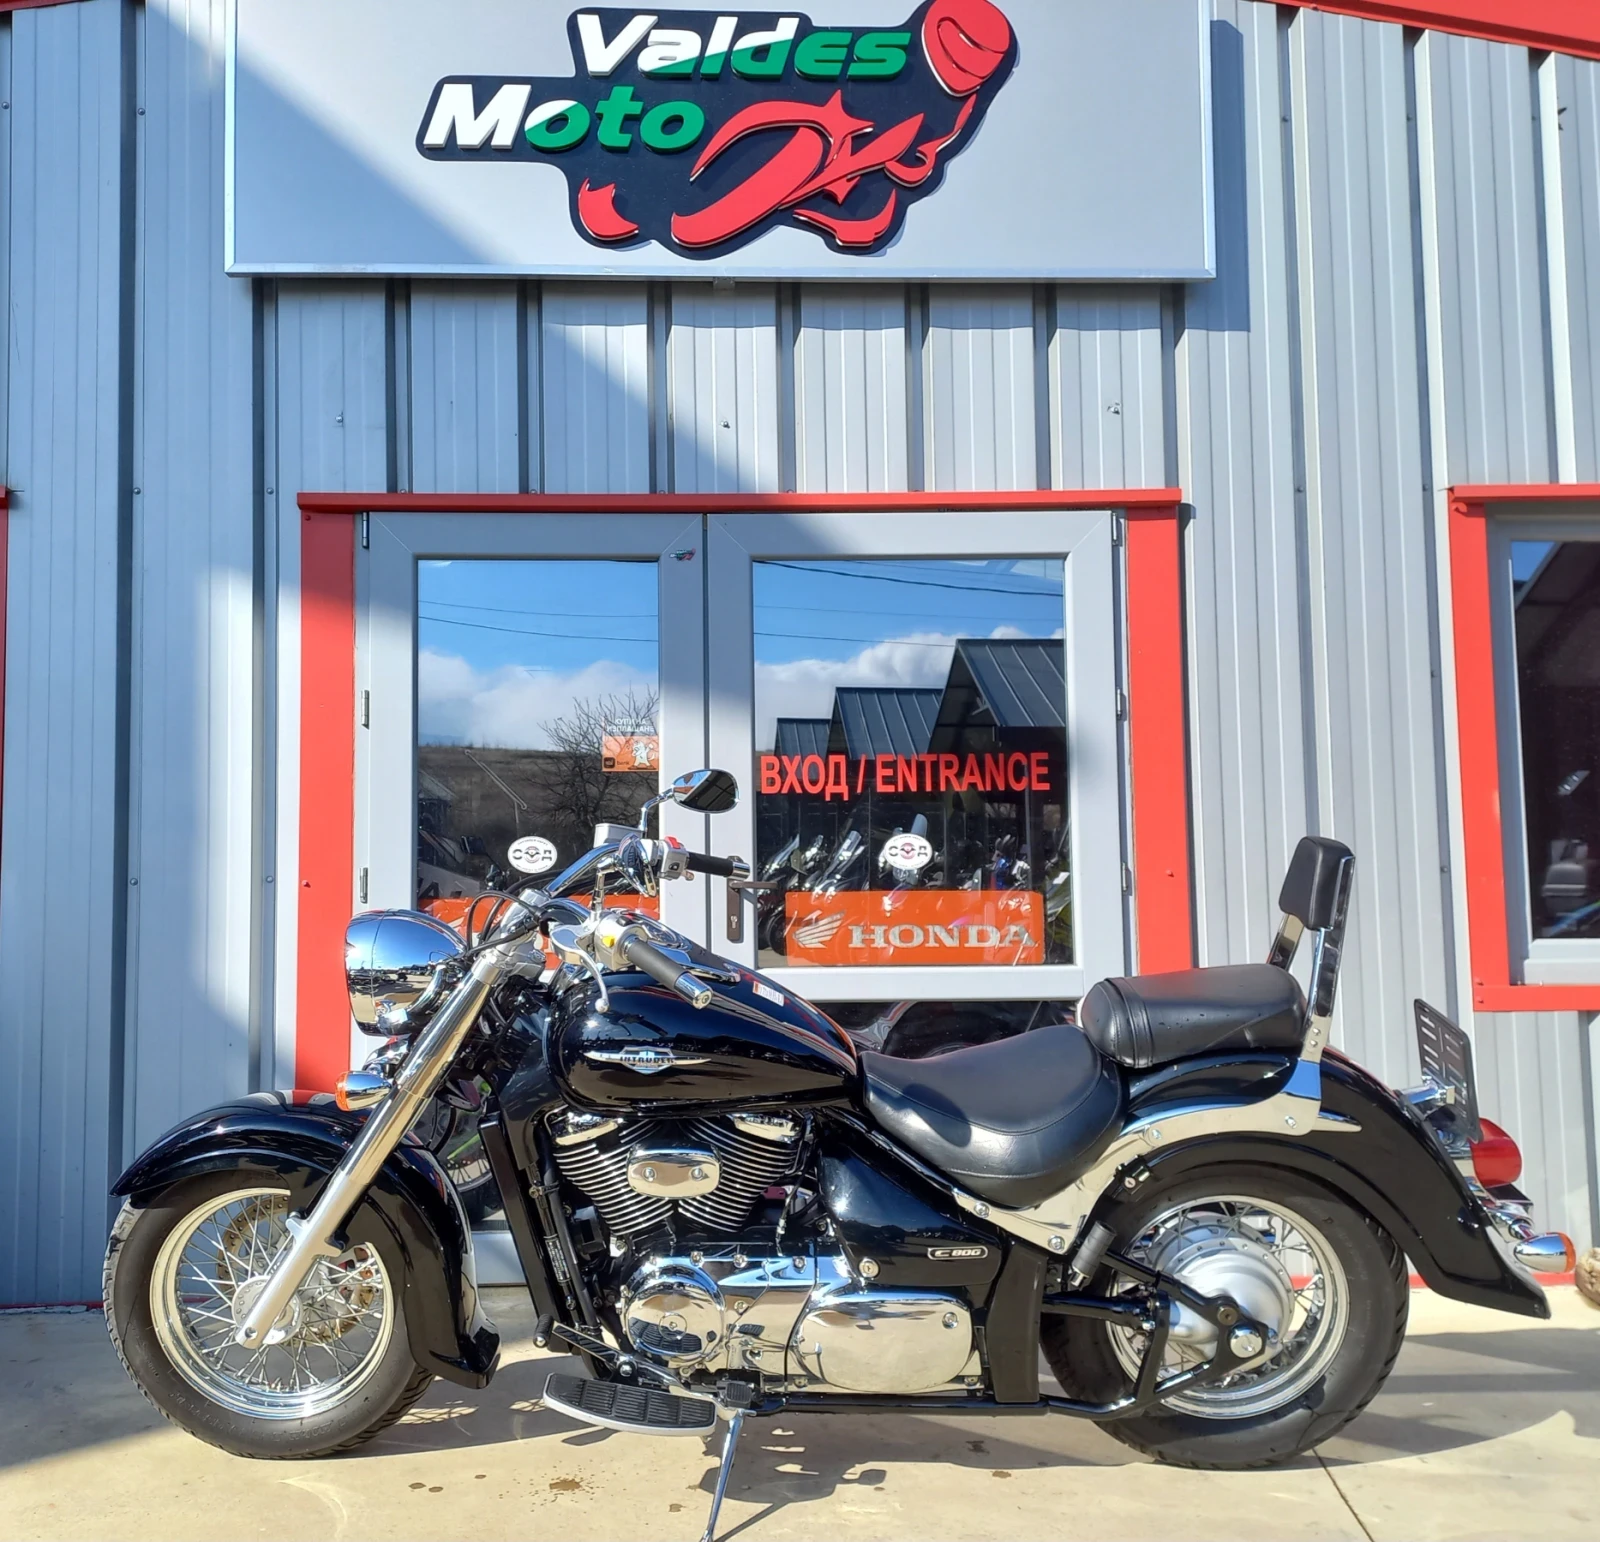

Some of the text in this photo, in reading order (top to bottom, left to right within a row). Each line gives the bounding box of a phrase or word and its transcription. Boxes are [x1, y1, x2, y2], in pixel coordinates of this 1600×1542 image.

[576, 14, 911, 80] Valdes
[424, 83, 704, 153] Moto
[761, 754, 849, 801] ВХОД
[875, 752, 1050, 793] ENTRANCE
[848, 924, 1034, 949] HONDA
[619, 1055, 675, 1064] INTRUDER
